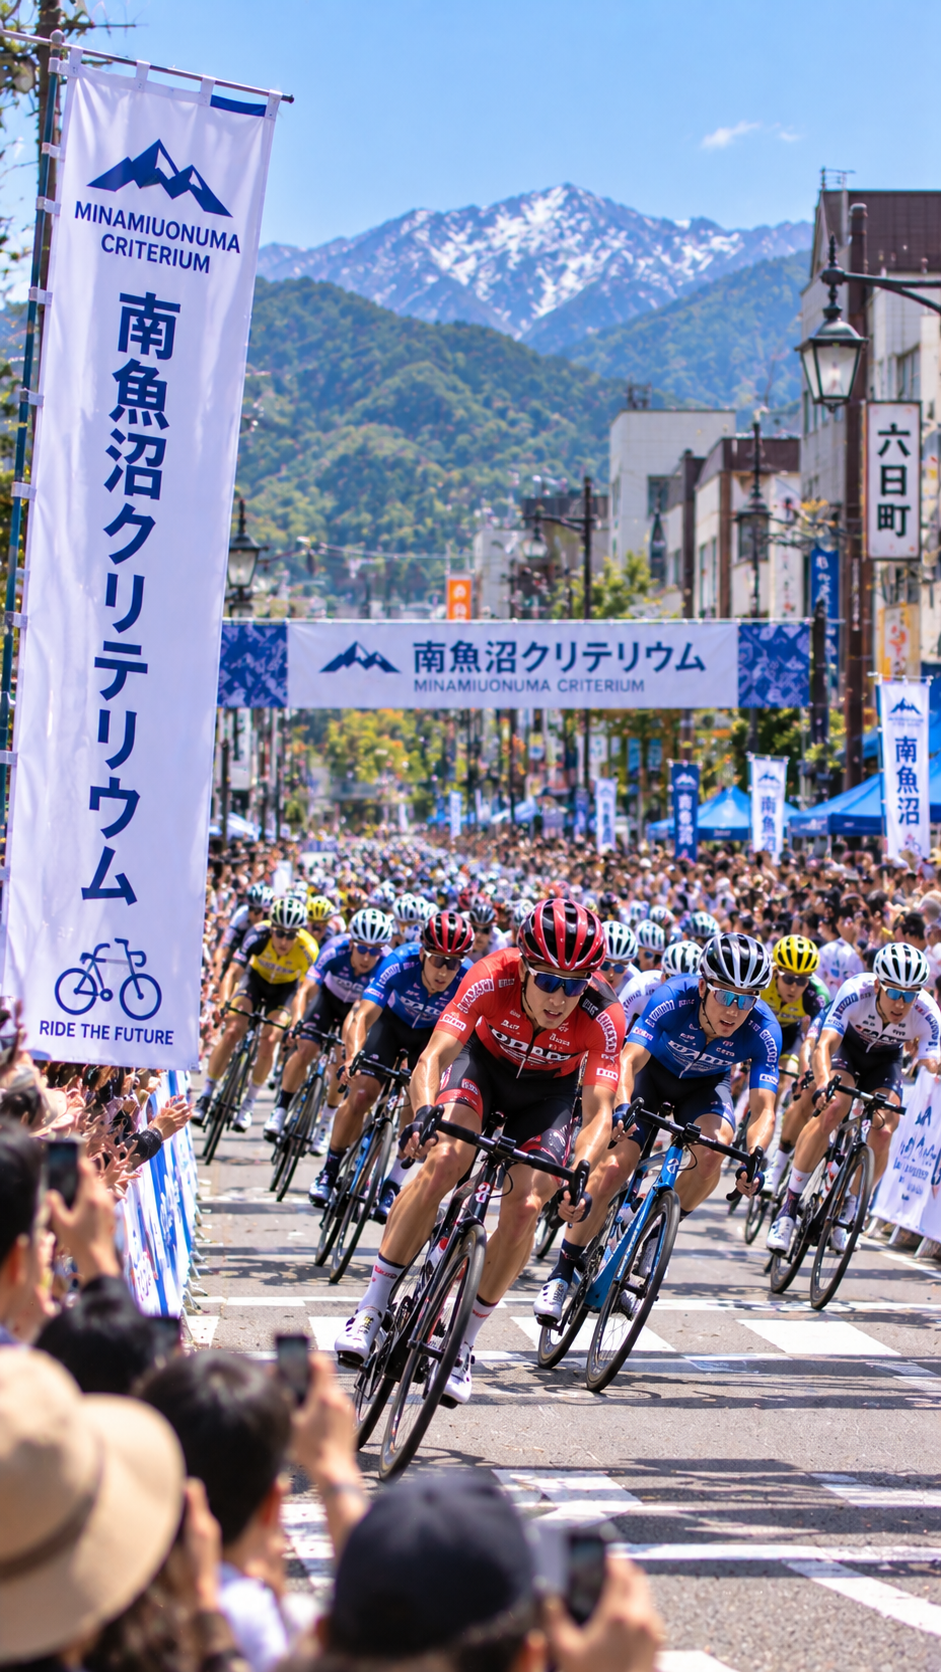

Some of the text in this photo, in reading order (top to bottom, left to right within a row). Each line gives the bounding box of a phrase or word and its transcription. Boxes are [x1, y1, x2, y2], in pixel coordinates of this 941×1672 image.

[74, 200, 241, 254] MINAMIUONUMA
[100, 233, 211, 274] CRITERIUM
[877, 422, 911, 538] 六日町
[80, 291, 182, 907] 南魚沼クリテリウム
[412, 640, 706, 674] 南魚沼クリテリウム
[413, 678, 645, 693] MINAMIUONUMA CRITERIUM
[894, 735, 920, 826] 南魚沼
[39, 1020, 174, 1045] RIDE THE FUTURE
